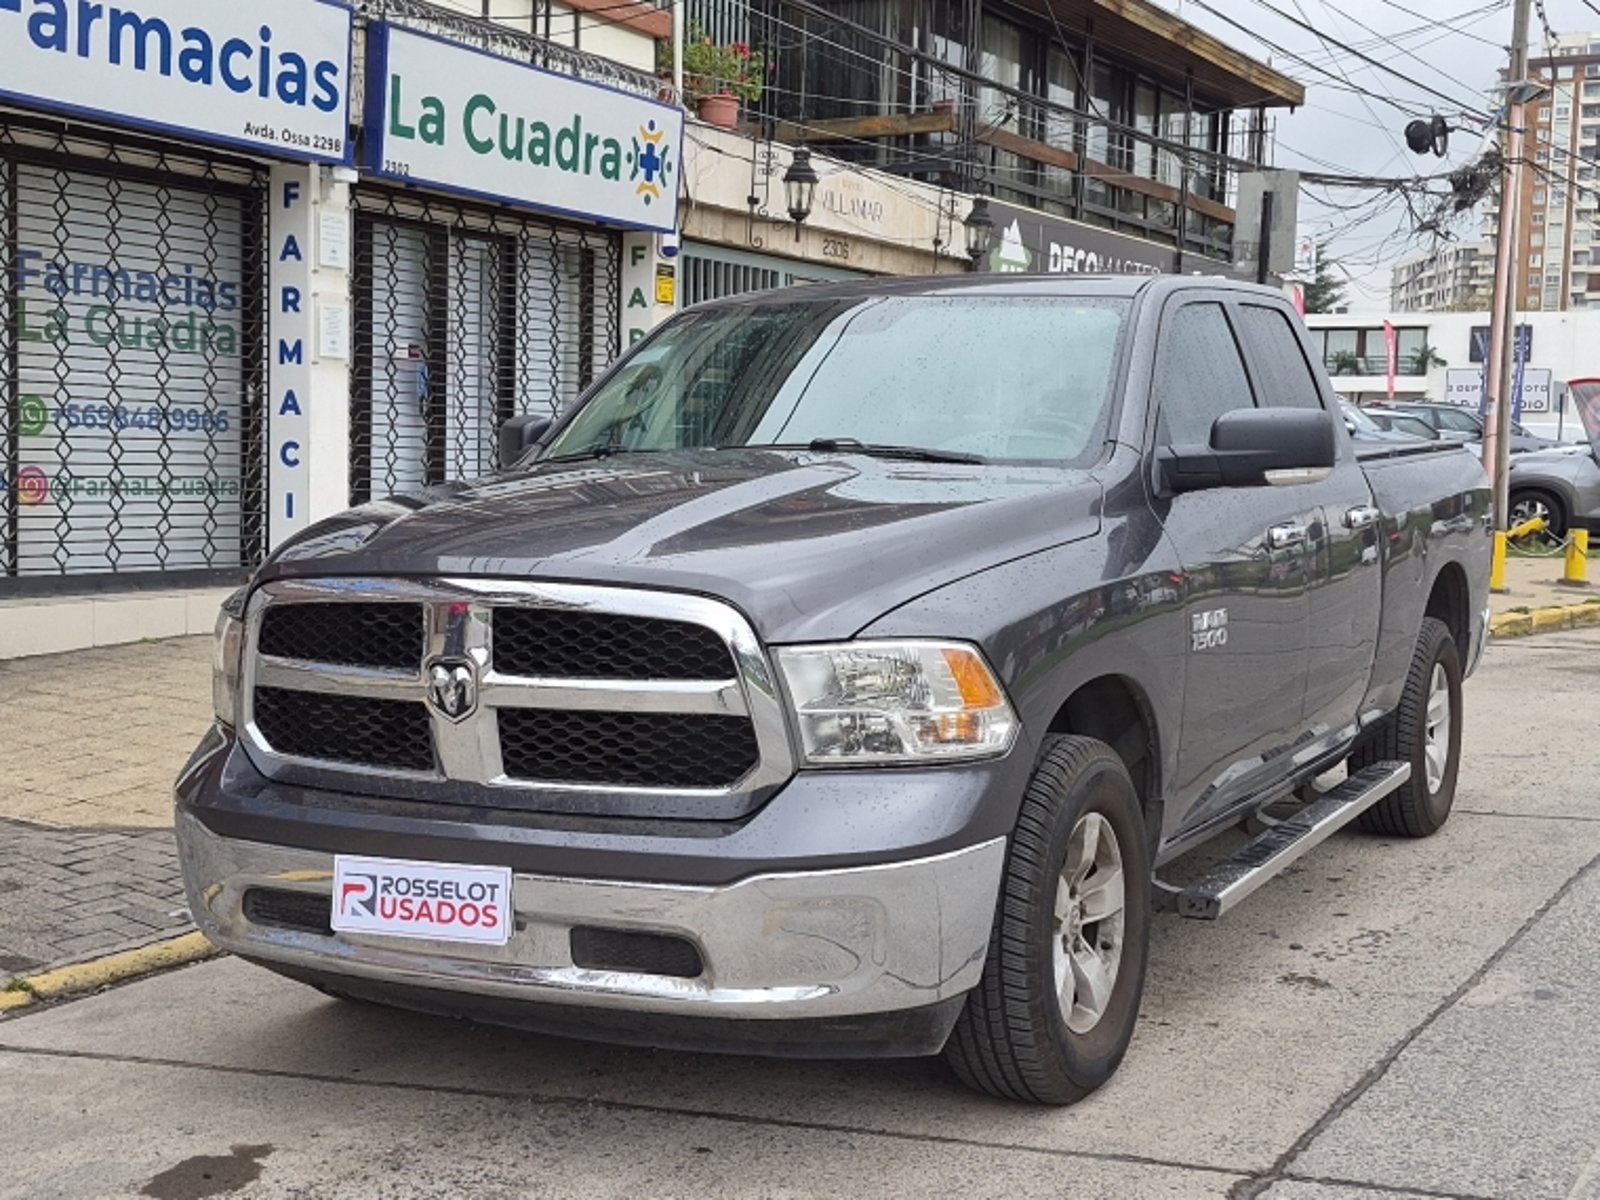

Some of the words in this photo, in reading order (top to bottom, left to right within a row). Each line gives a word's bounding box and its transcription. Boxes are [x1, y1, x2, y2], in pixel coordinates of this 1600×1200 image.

[0, 0, 339, 112] armacias
[281, 128, 311, 146] Ossa
[390, 74, 445, 146] La
[463, 94, 622, 182] Cuadra
[16, 250, 237, 312] Farmacias
[17, 300, 68, 342] La
[85, 304, 236, 354] Cuadra
[380, 876, 499, 902] ROSSELOT
[380, 896, 498, 929] USADOS
